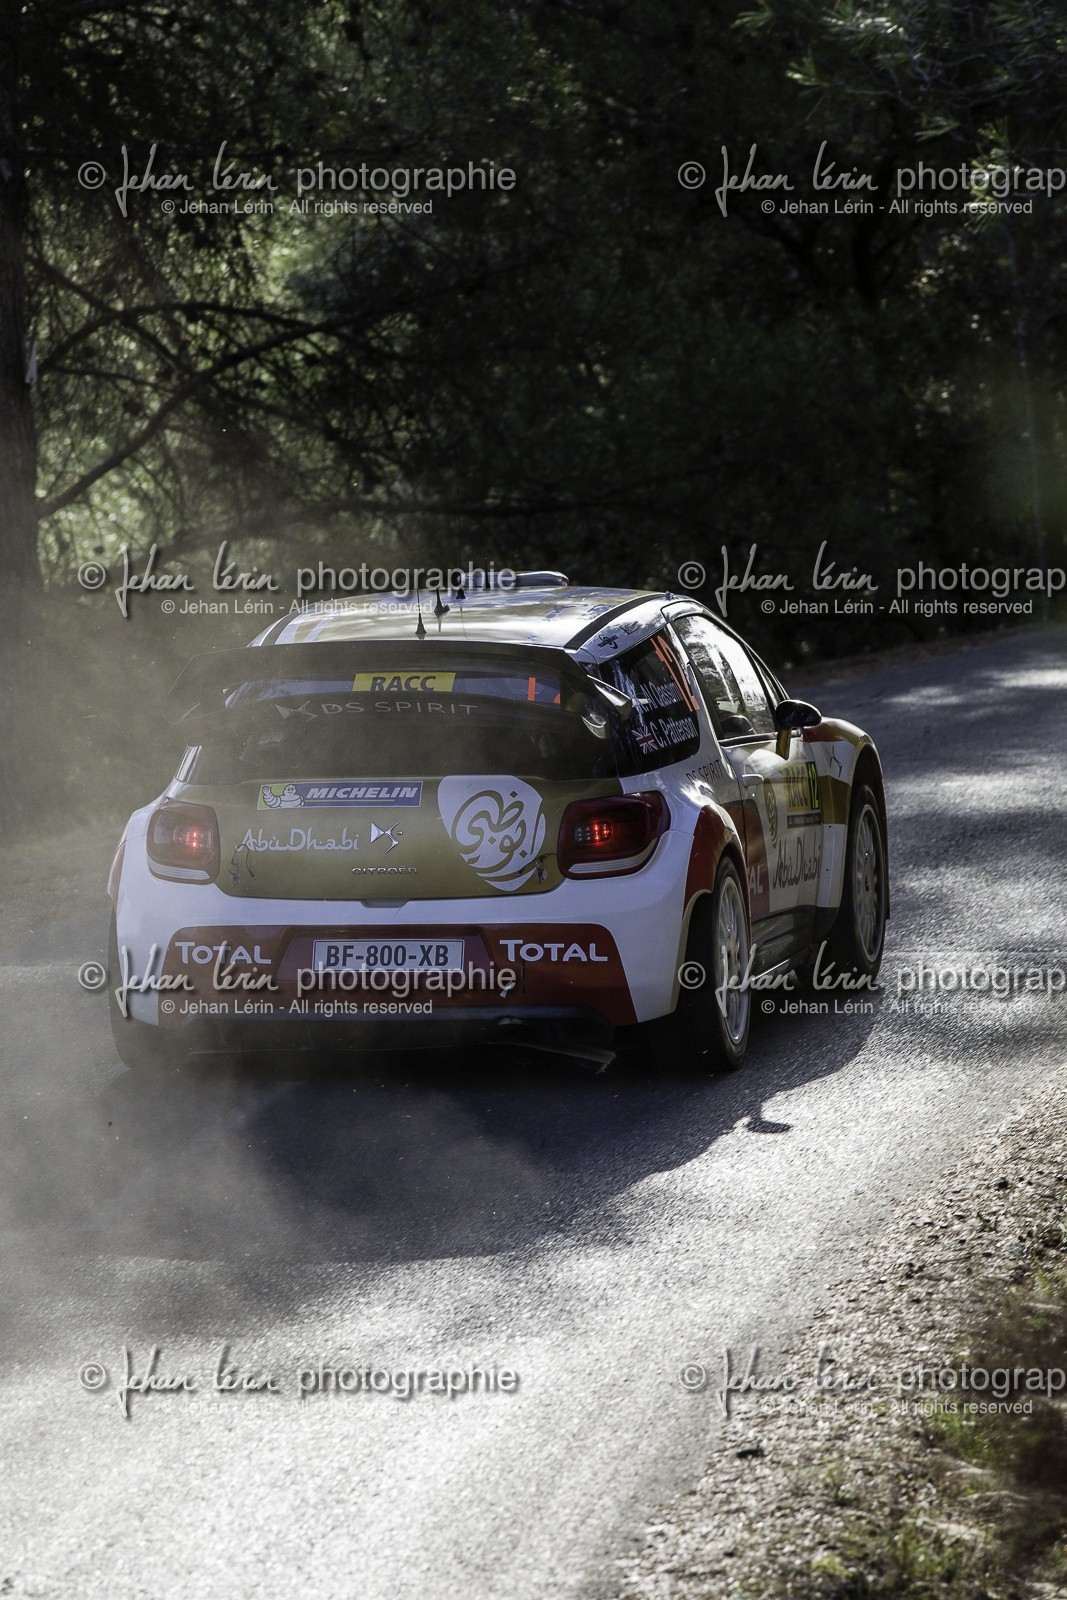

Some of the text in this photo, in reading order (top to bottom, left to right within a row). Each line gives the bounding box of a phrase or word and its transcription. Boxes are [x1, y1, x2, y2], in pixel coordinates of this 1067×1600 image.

[369, 675, 436, 692] RACC
[320, 701, 478, 716] DS SPIRIT
[698, 759, 724, 782] SPIRIT
[306, 787, 419, 799] MICHELIN
[174, 941, 272, 965] TOTAL
[326, 944, 450, 968] BF-800-XB
[500, 940, 608, 962] TOTAL
